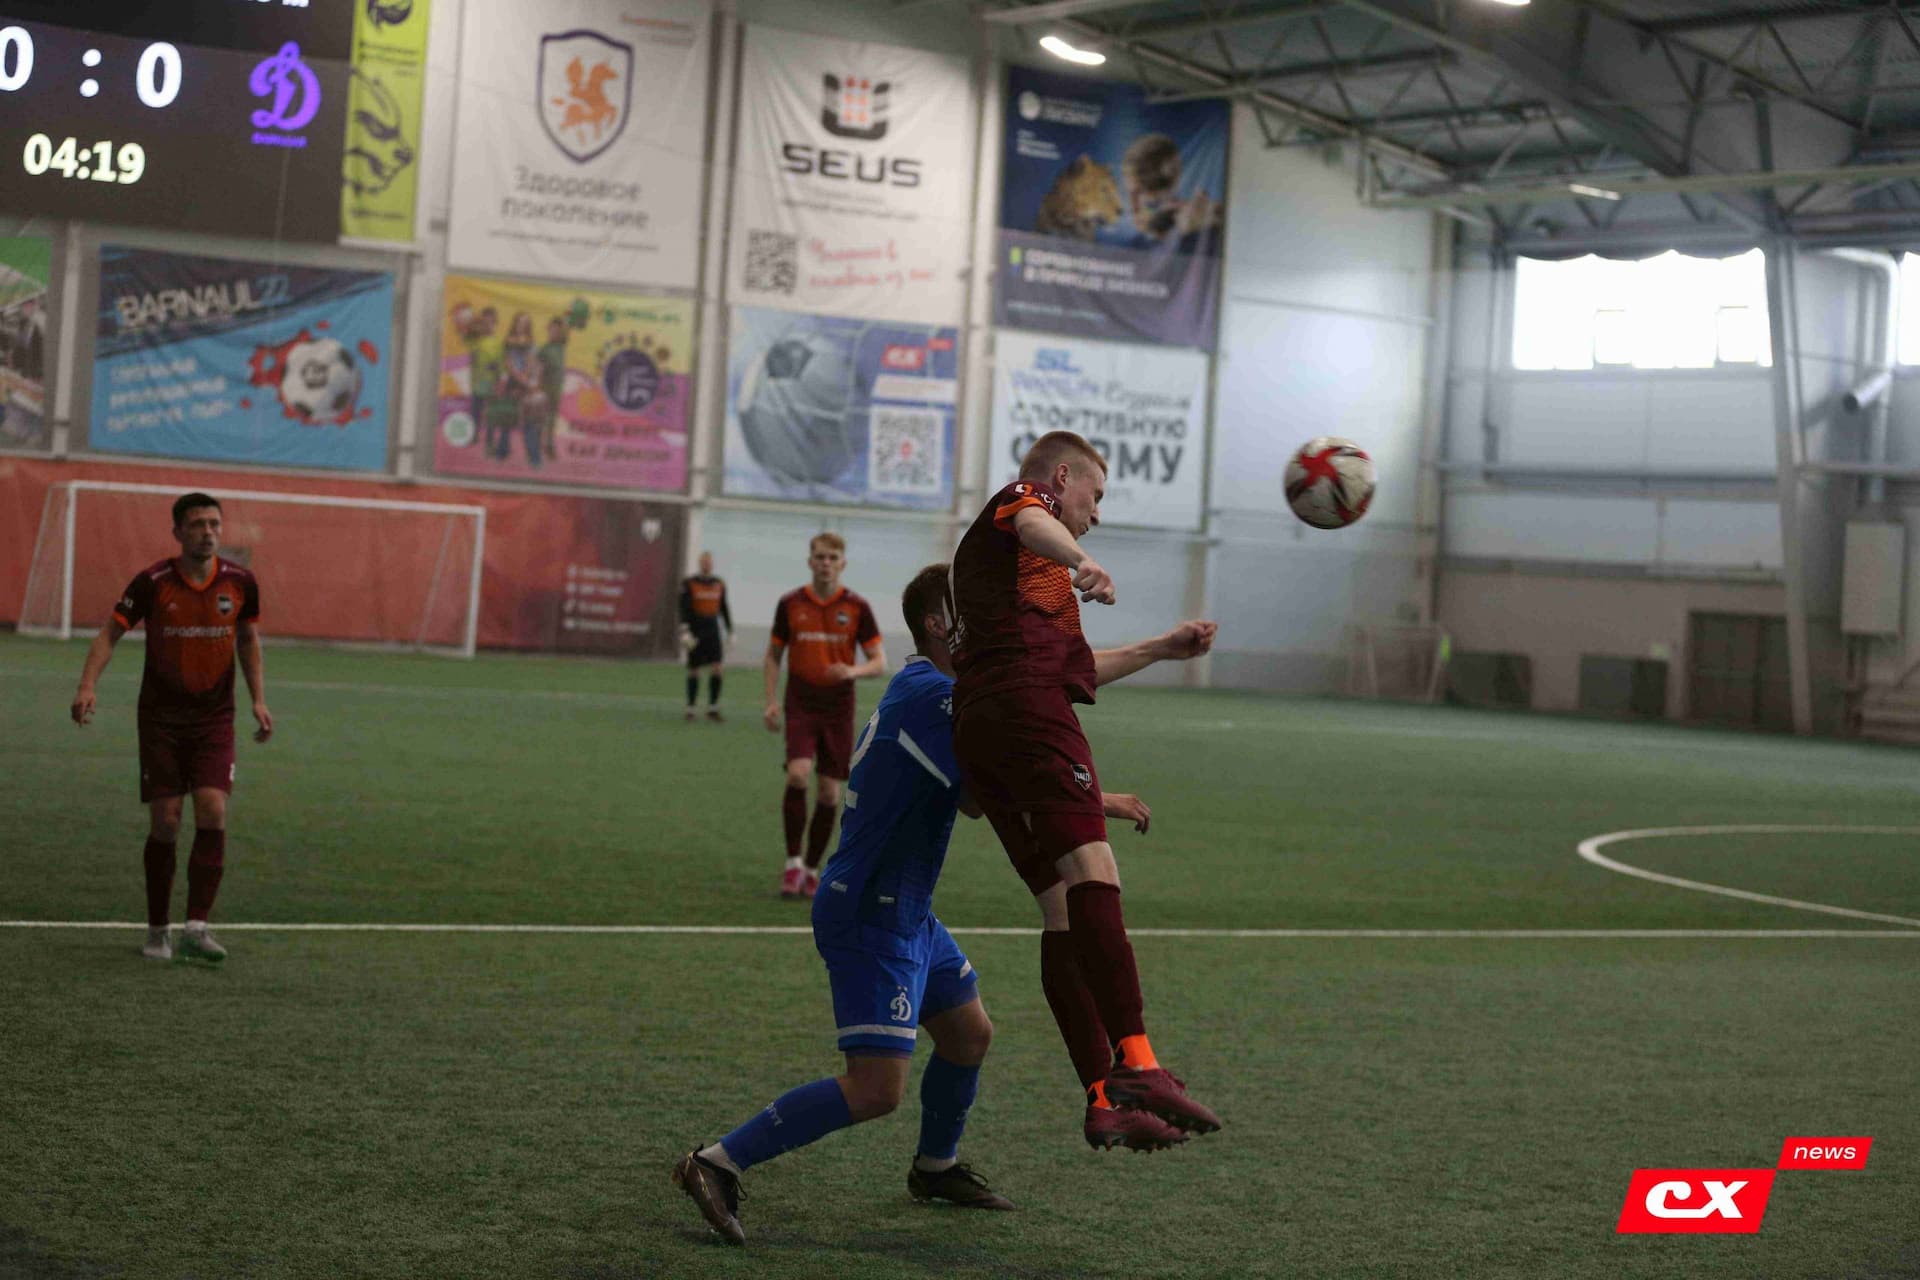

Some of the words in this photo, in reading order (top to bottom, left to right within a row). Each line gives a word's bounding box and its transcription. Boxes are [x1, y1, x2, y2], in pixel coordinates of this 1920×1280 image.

[0, 25, 34, 92] 0
[136, 41, 183, 108] 0
[23, 133, 146, 185] 04:19
[782, 142, 922, 188] SEUS
